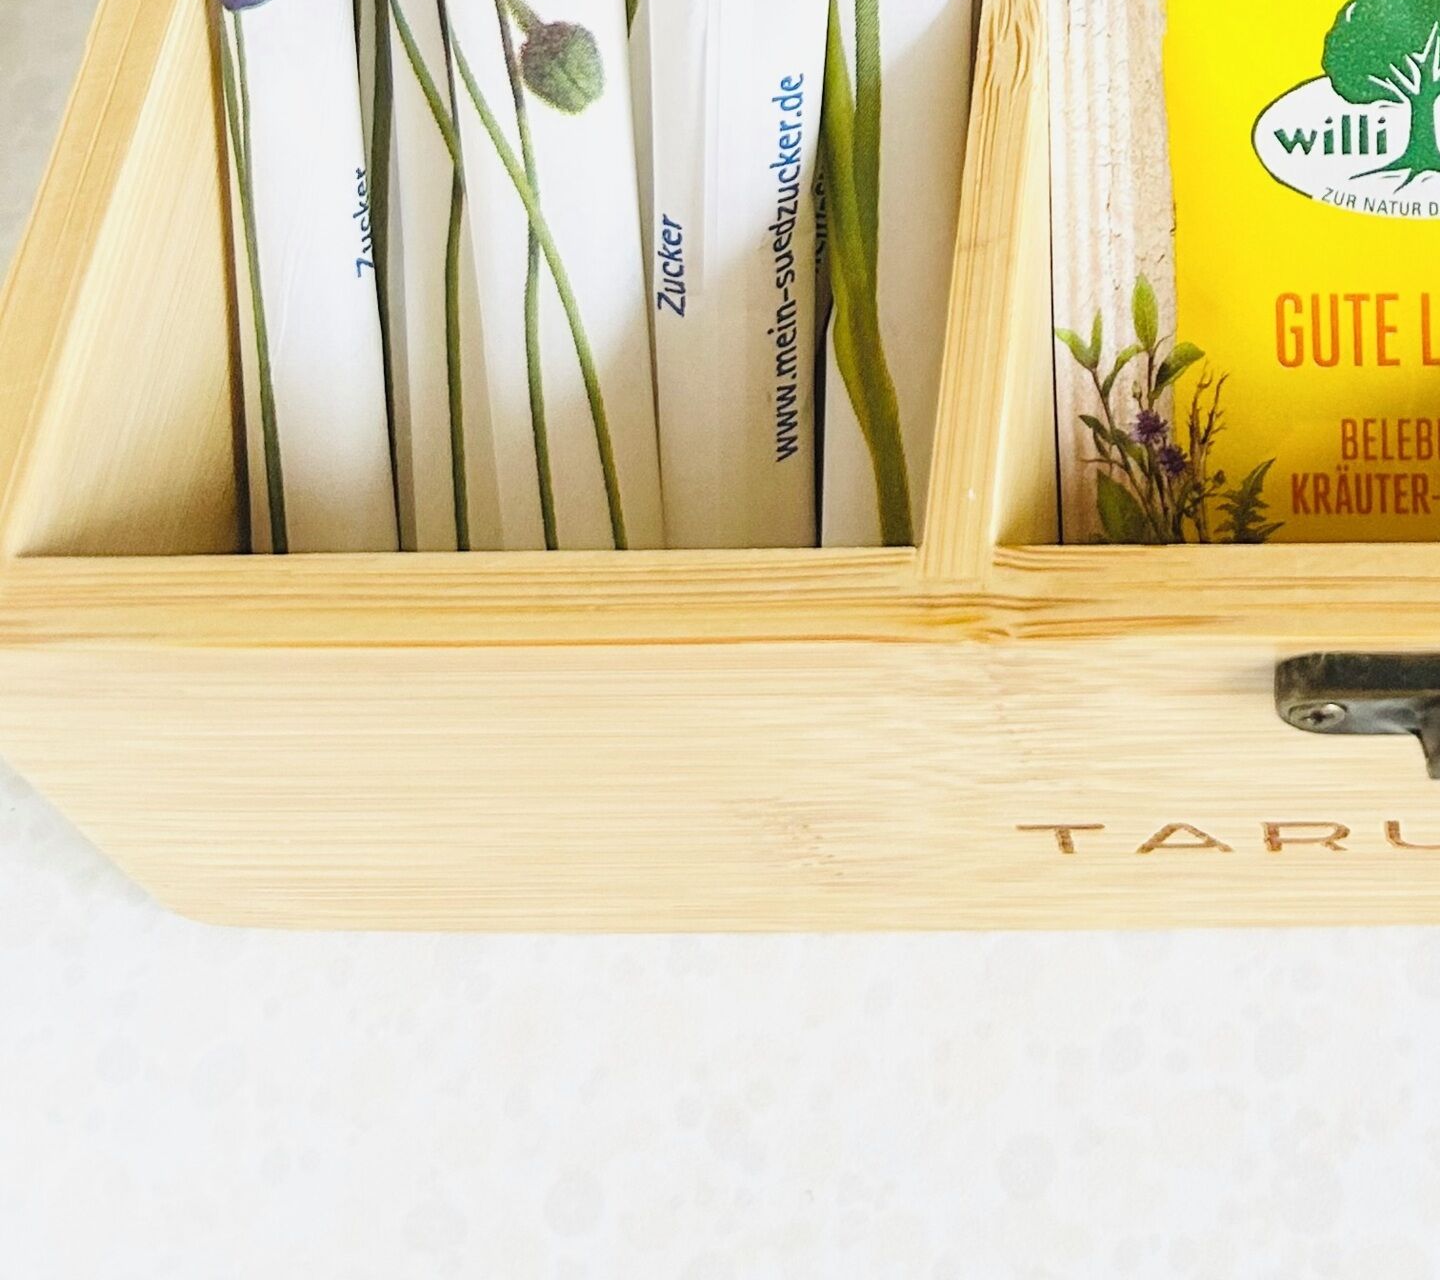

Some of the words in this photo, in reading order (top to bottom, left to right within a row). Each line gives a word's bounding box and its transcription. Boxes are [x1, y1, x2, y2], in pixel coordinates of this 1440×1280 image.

[1273, 114, 1389, 156] willi
[1321, 186, 1357, 209] ZUR
[1363, 196, 1423, 217] NATUR
[657, 212, 687, 319] Zucker
[768, 72, 805, 463] www.mein-suedzucker.de
[1275, 291, 1401, 369] GUTE
